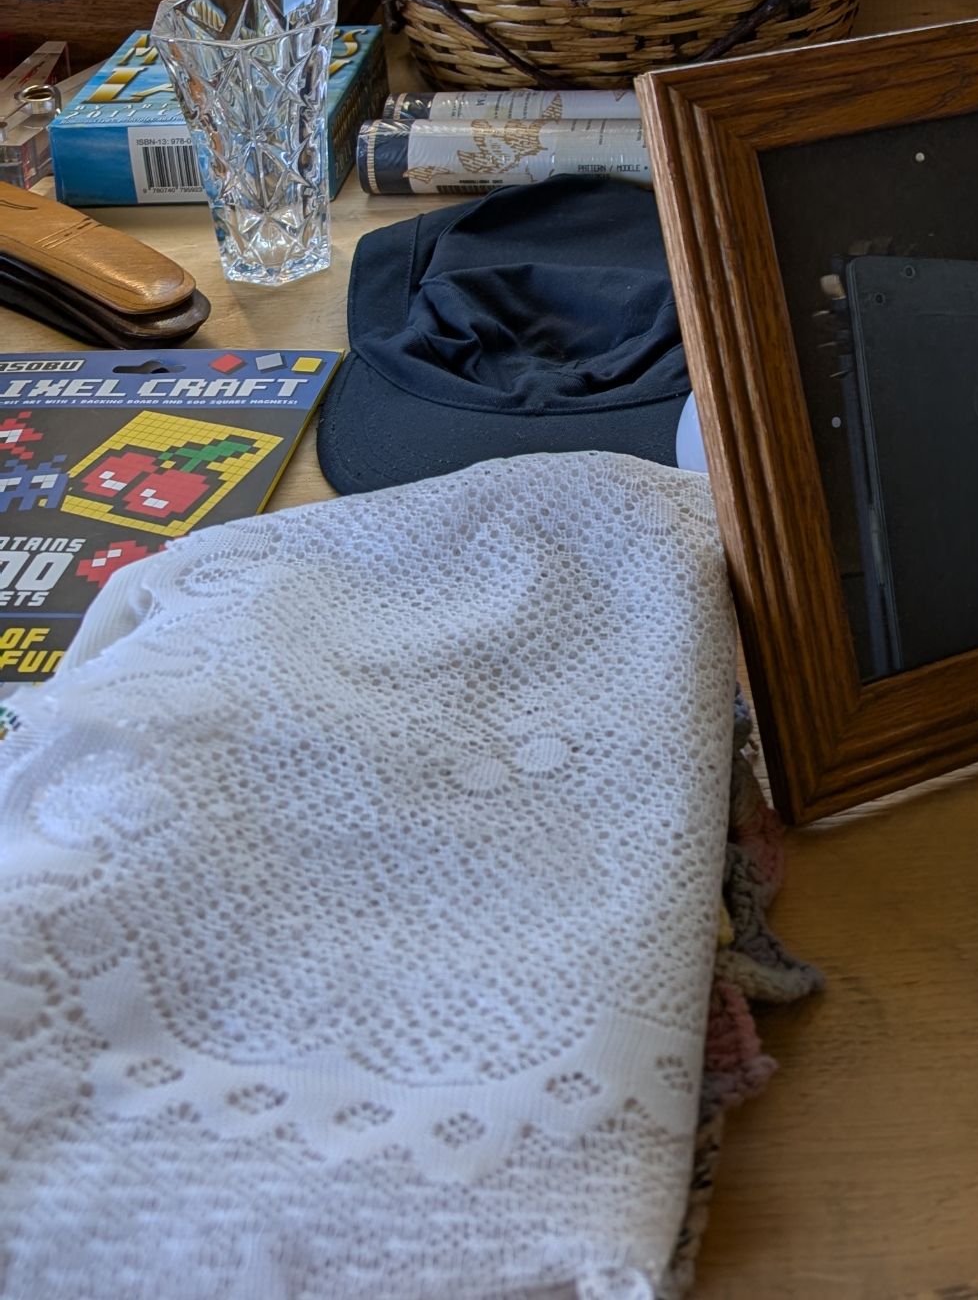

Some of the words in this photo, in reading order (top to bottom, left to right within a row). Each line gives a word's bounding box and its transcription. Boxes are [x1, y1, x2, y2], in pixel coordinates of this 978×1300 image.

[0, 378, 126, 398] IXEL
[137, 378, 309, 397] CRAFT
[0, 536, 87, 553] TAINS
[0, 550, 75, 591] 00
[0, 627, 51, 650] OF
